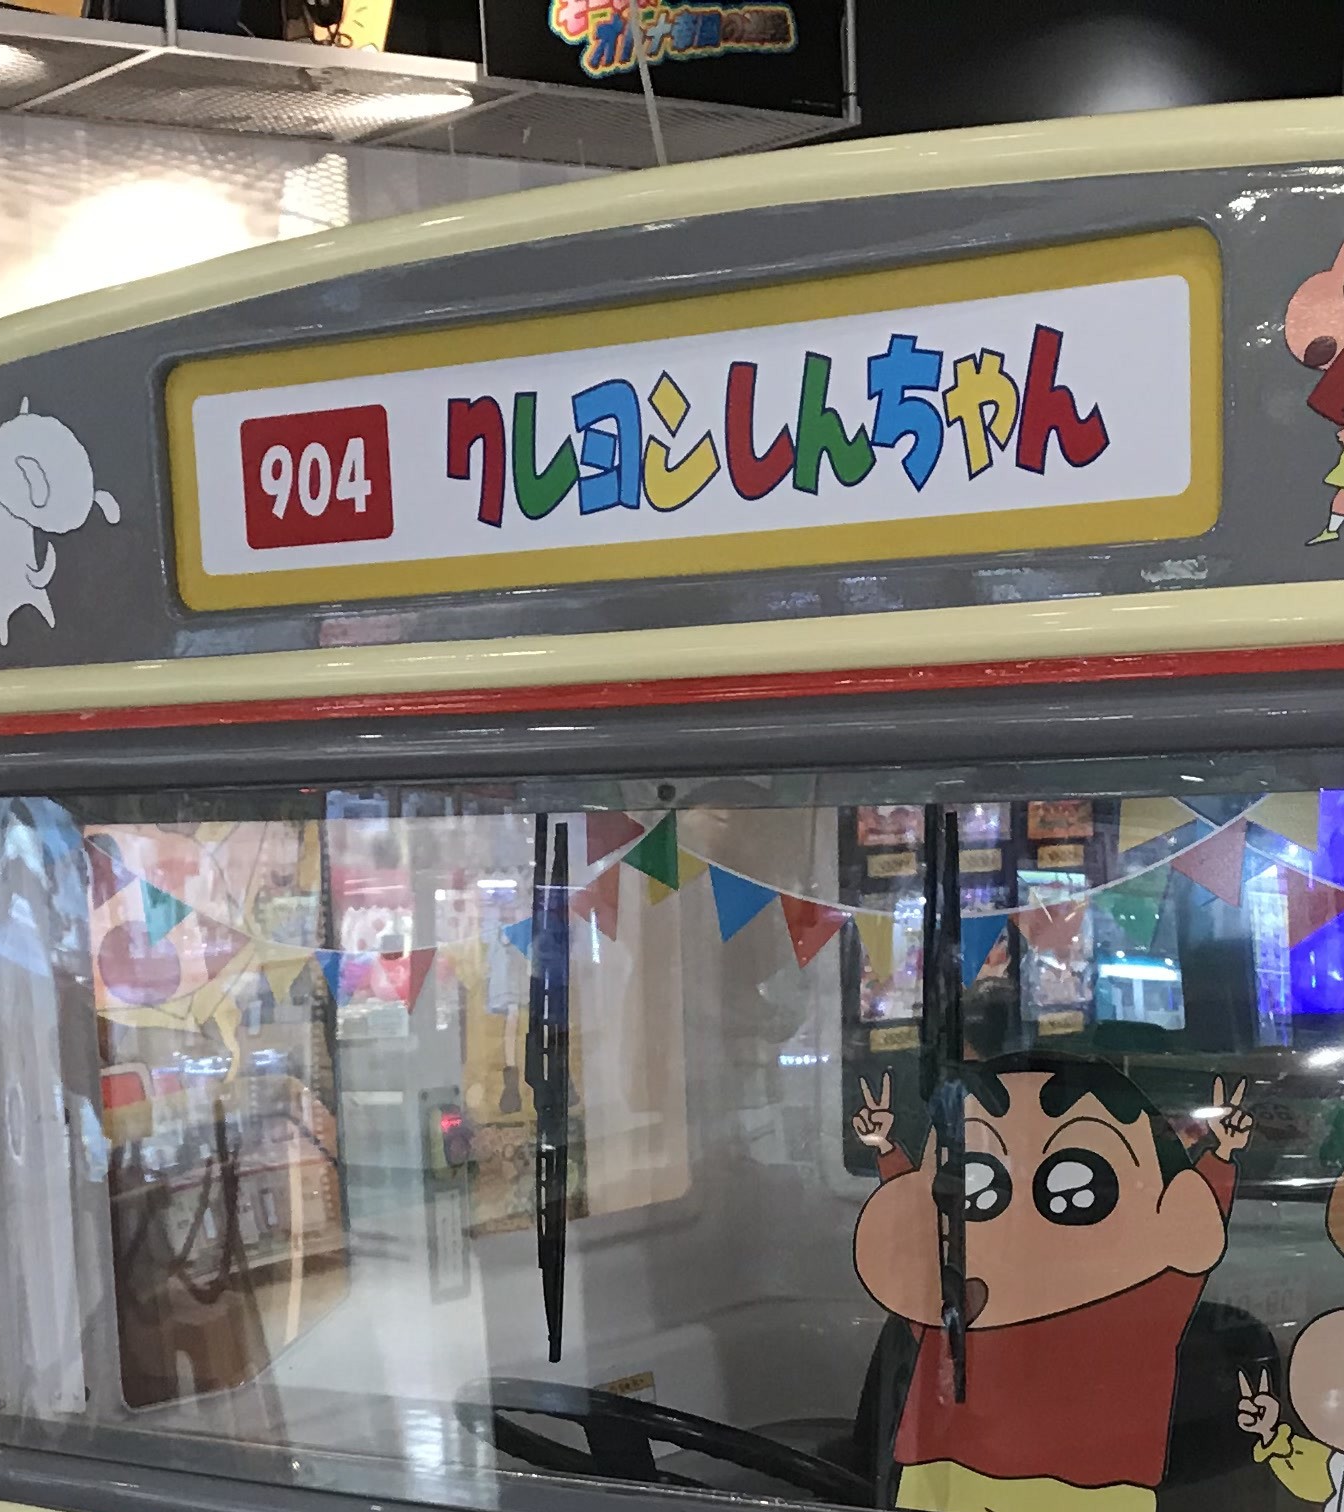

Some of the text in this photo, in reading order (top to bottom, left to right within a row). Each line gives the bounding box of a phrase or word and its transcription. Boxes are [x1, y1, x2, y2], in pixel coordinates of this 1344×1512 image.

[258, 436, 372, 521] 904
[447, 324, 1109, 528] クレヨンしんちゃん
